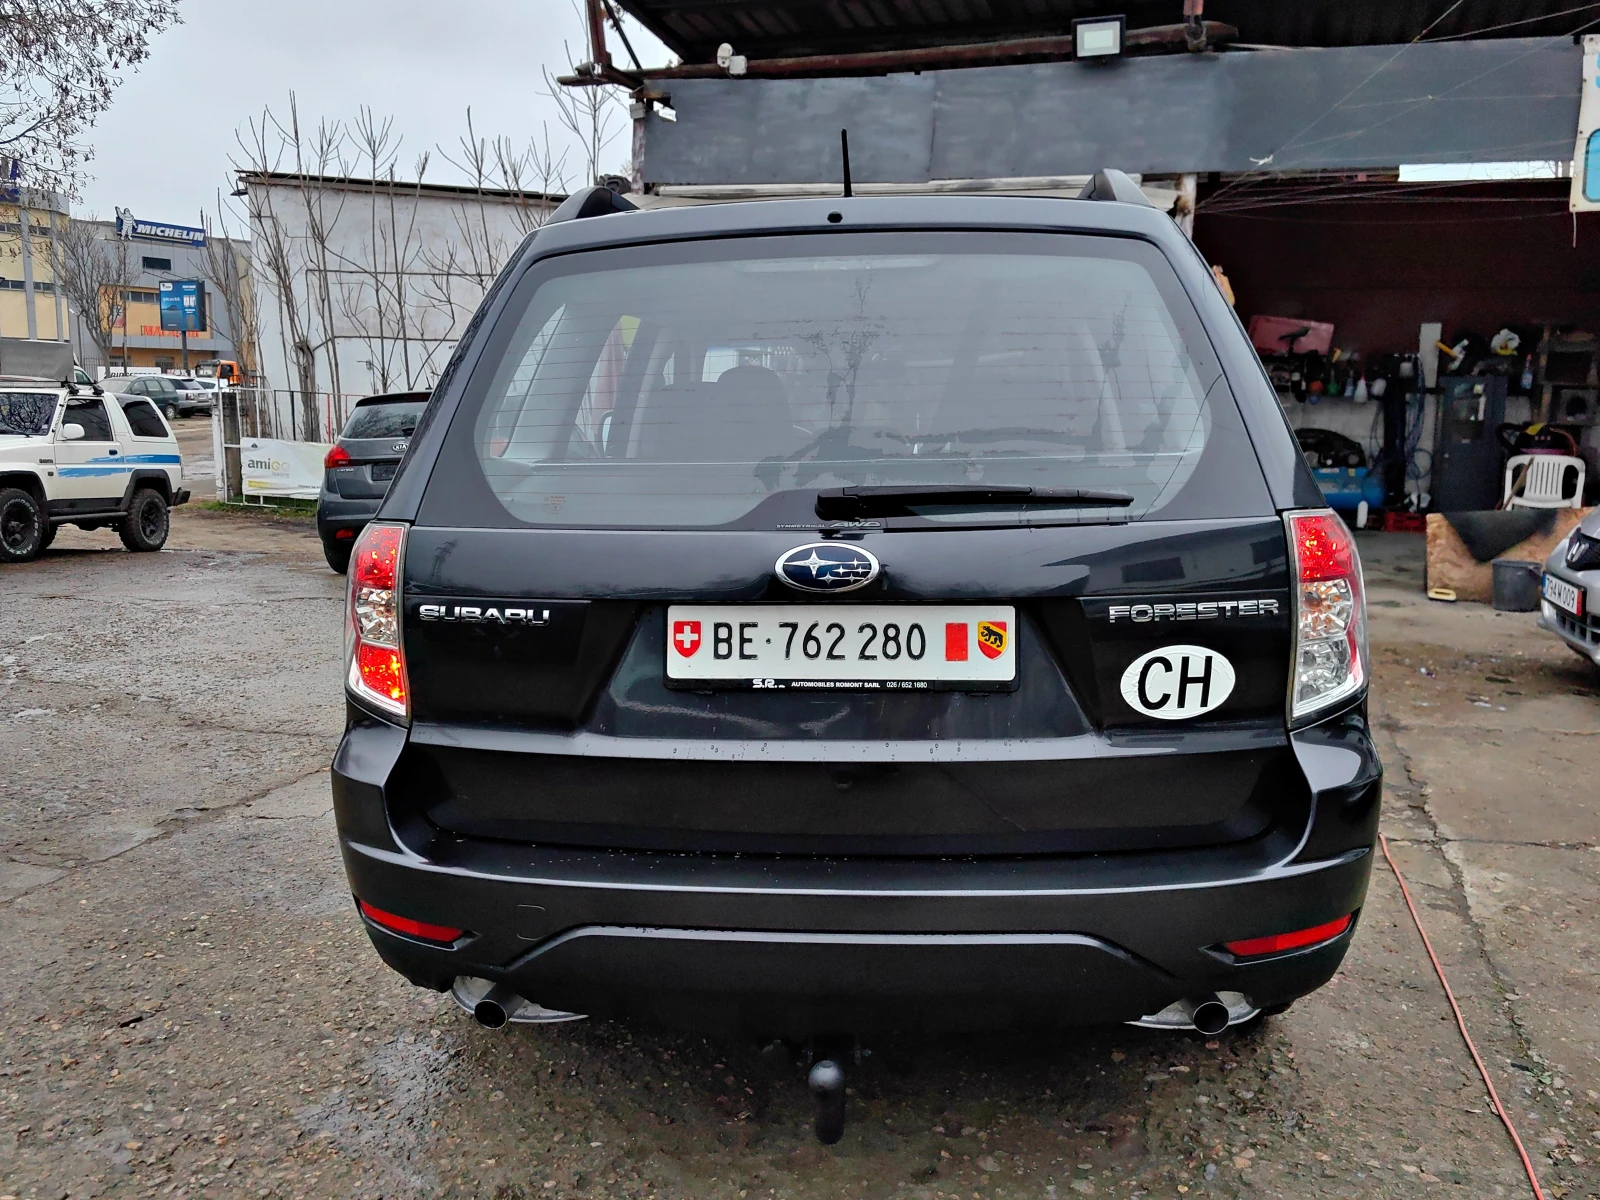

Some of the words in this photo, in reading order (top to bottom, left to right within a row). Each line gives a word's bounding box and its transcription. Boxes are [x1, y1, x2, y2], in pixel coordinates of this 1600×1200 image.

[136, 224, 205, 241] MICHELIN
[419, 604, 550, 626] SUBARU
[1108, 599, 1279, 623] FORESTER
[1137, 655, 1213, 711] CH
